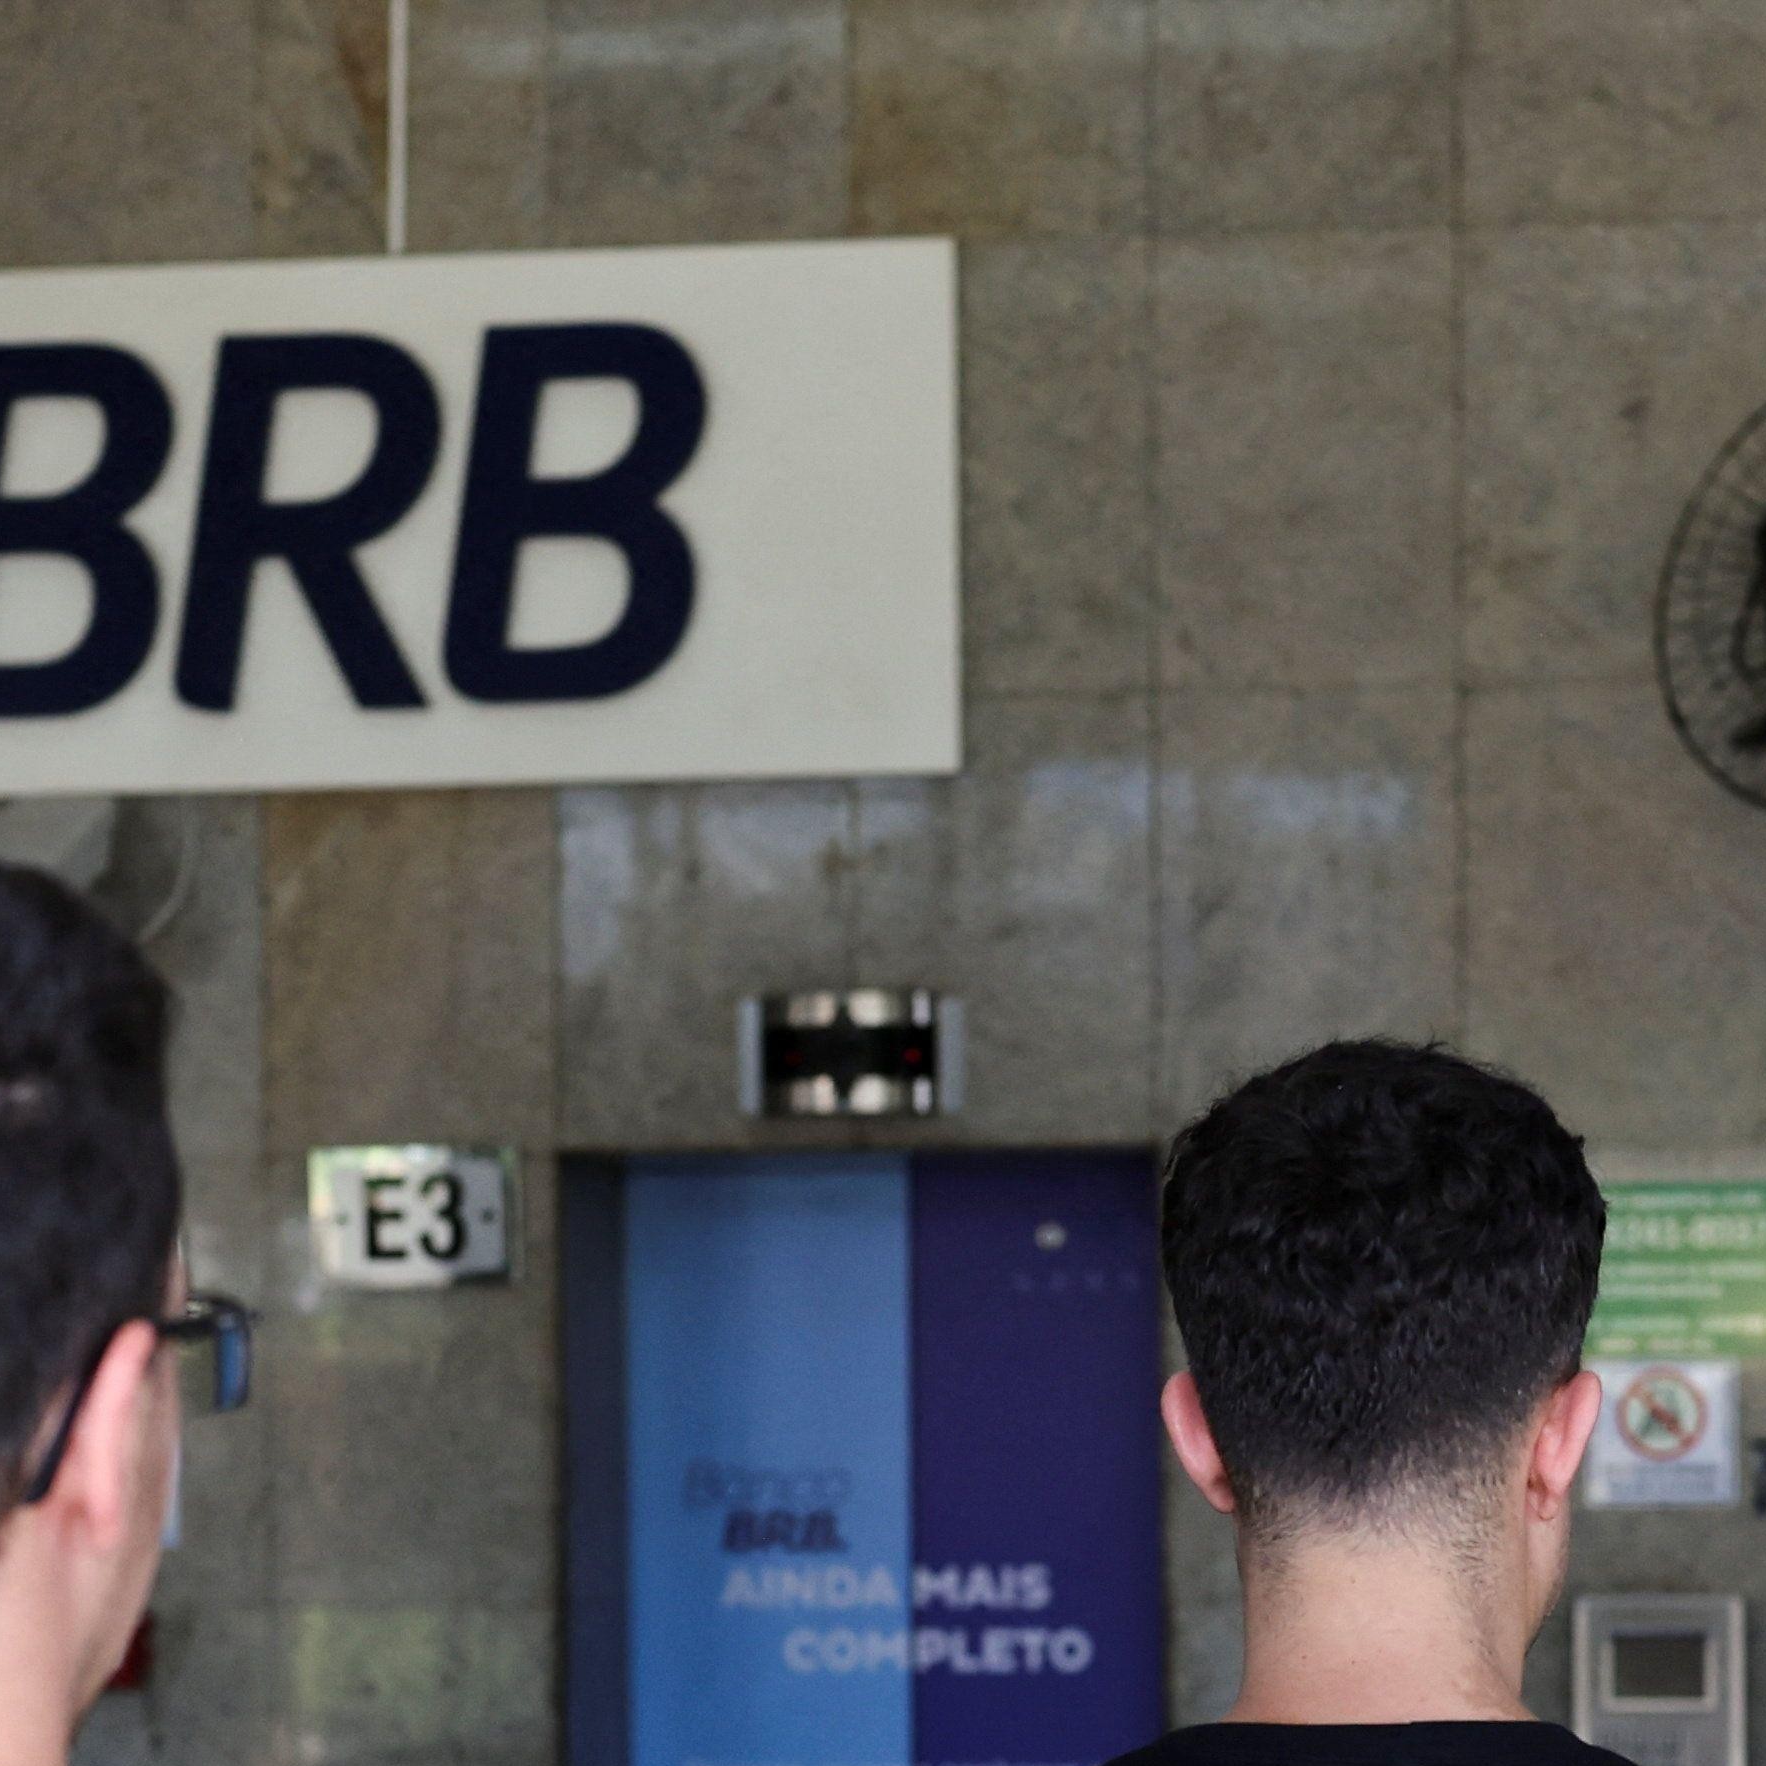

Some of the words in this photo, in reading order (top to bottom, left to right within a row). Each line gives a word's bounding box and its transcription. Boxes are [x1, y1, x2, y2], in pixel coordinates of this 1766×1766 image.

[363, 1174, 468, 1263] E3
[720, 1564, 898, 1609] AINDA
[913, 1563, 1052, 1610] MAIS
[783, 1627, 1095, 1675] COMPLETO
